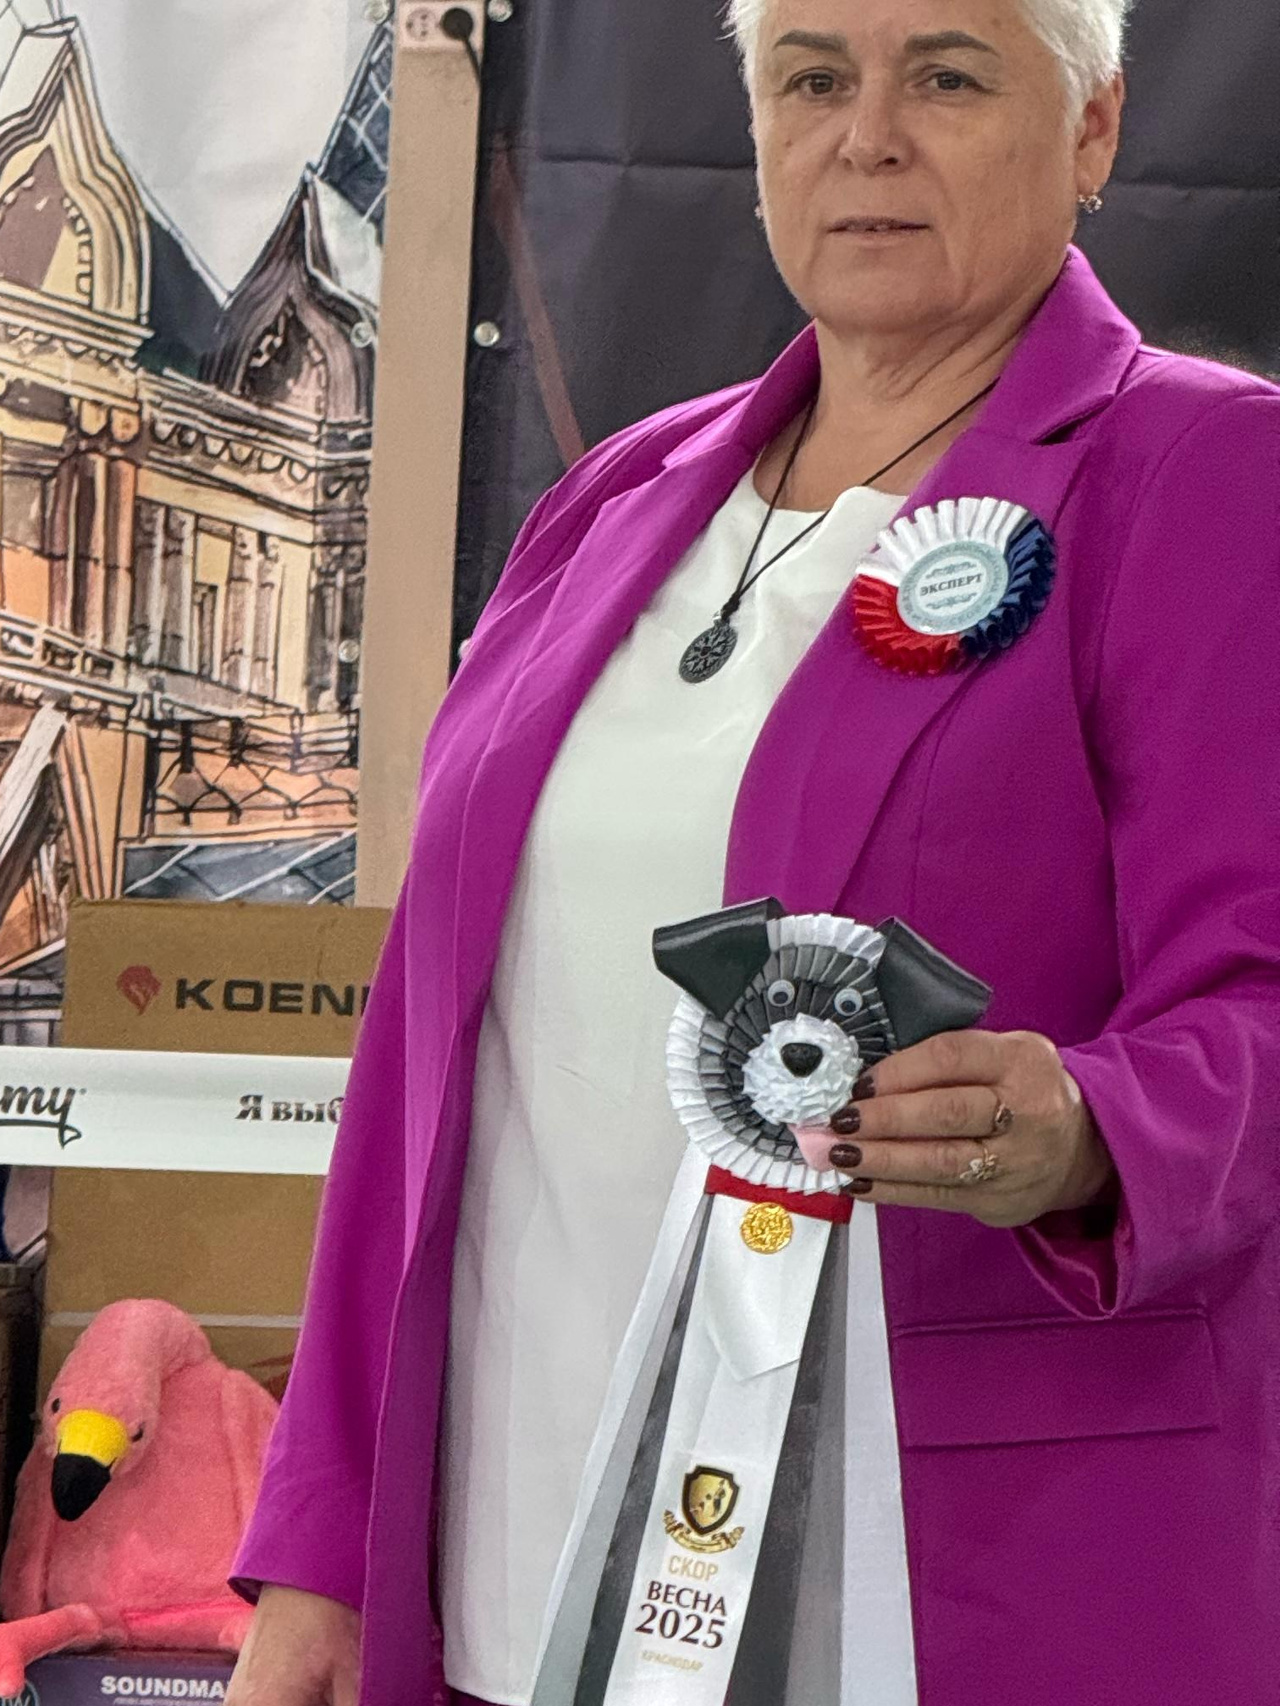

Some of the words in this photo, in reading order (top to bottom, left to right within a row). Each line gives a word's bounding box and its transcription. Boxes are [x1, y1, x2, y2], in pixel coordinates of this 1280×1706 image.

[920, 573, 983, 597] ЭКСПЕРТ
[234, 1094, 263, 1121] Я
[668, 1555, 719, 1582] СКОР
[646, 1580, 728, 1617] ВЕСНА
[634, 1602, 726, 1649] 2025
